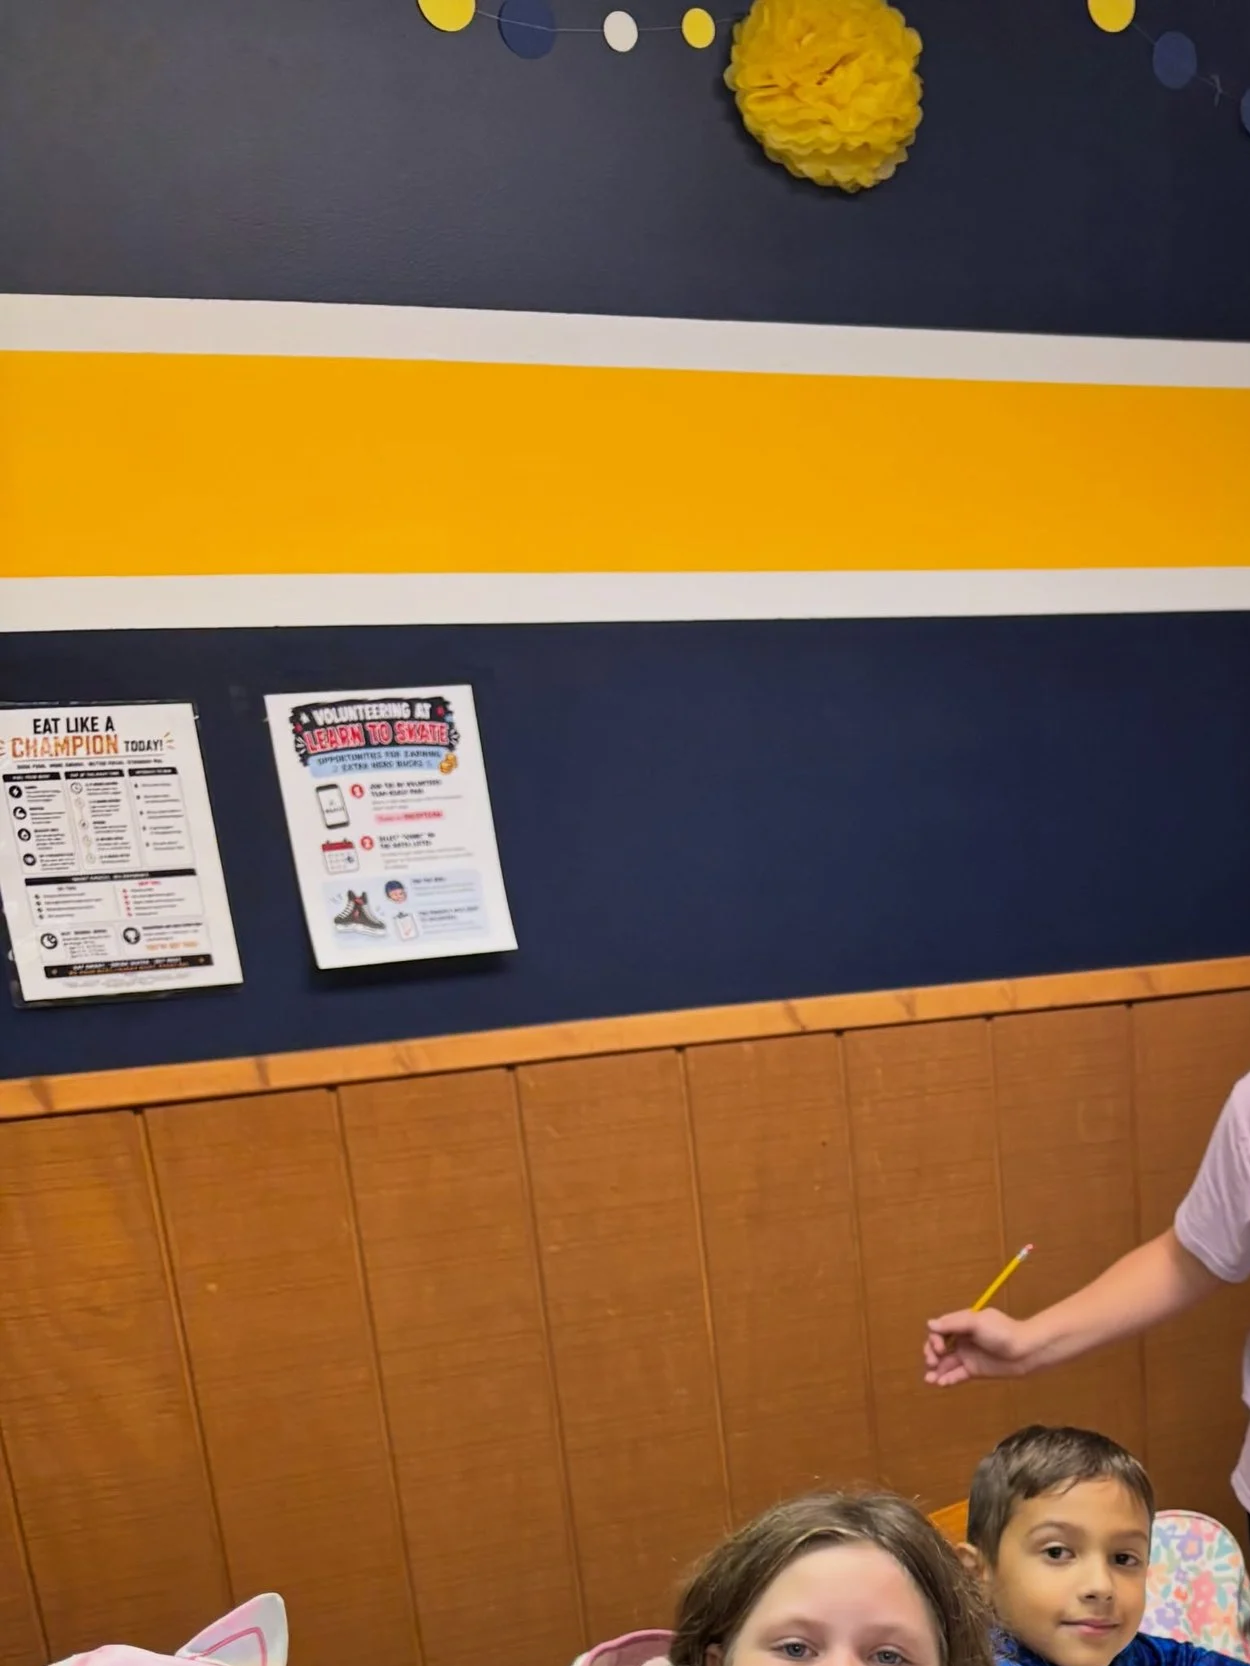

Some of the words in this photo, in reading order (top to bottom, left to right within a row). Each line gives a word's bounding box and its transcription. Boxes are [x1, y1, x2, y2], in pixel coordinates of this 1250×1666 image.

[33, 718, 61, 735] EAT
[66, 716, 99, 733] LIKE
[105, 715, 116, 732] A
[312, 702, 411, 726] VOLUNTEERING
[414, 702, 432, 720] AT
[11, 734, 119, 758] CHAMPION
[124, 739, 164, 753] TODAY!
[303, 723, 365, 754] LEARN
[366, 721, 393, 745] TO
[395, 721, 449, 745] SKATE
